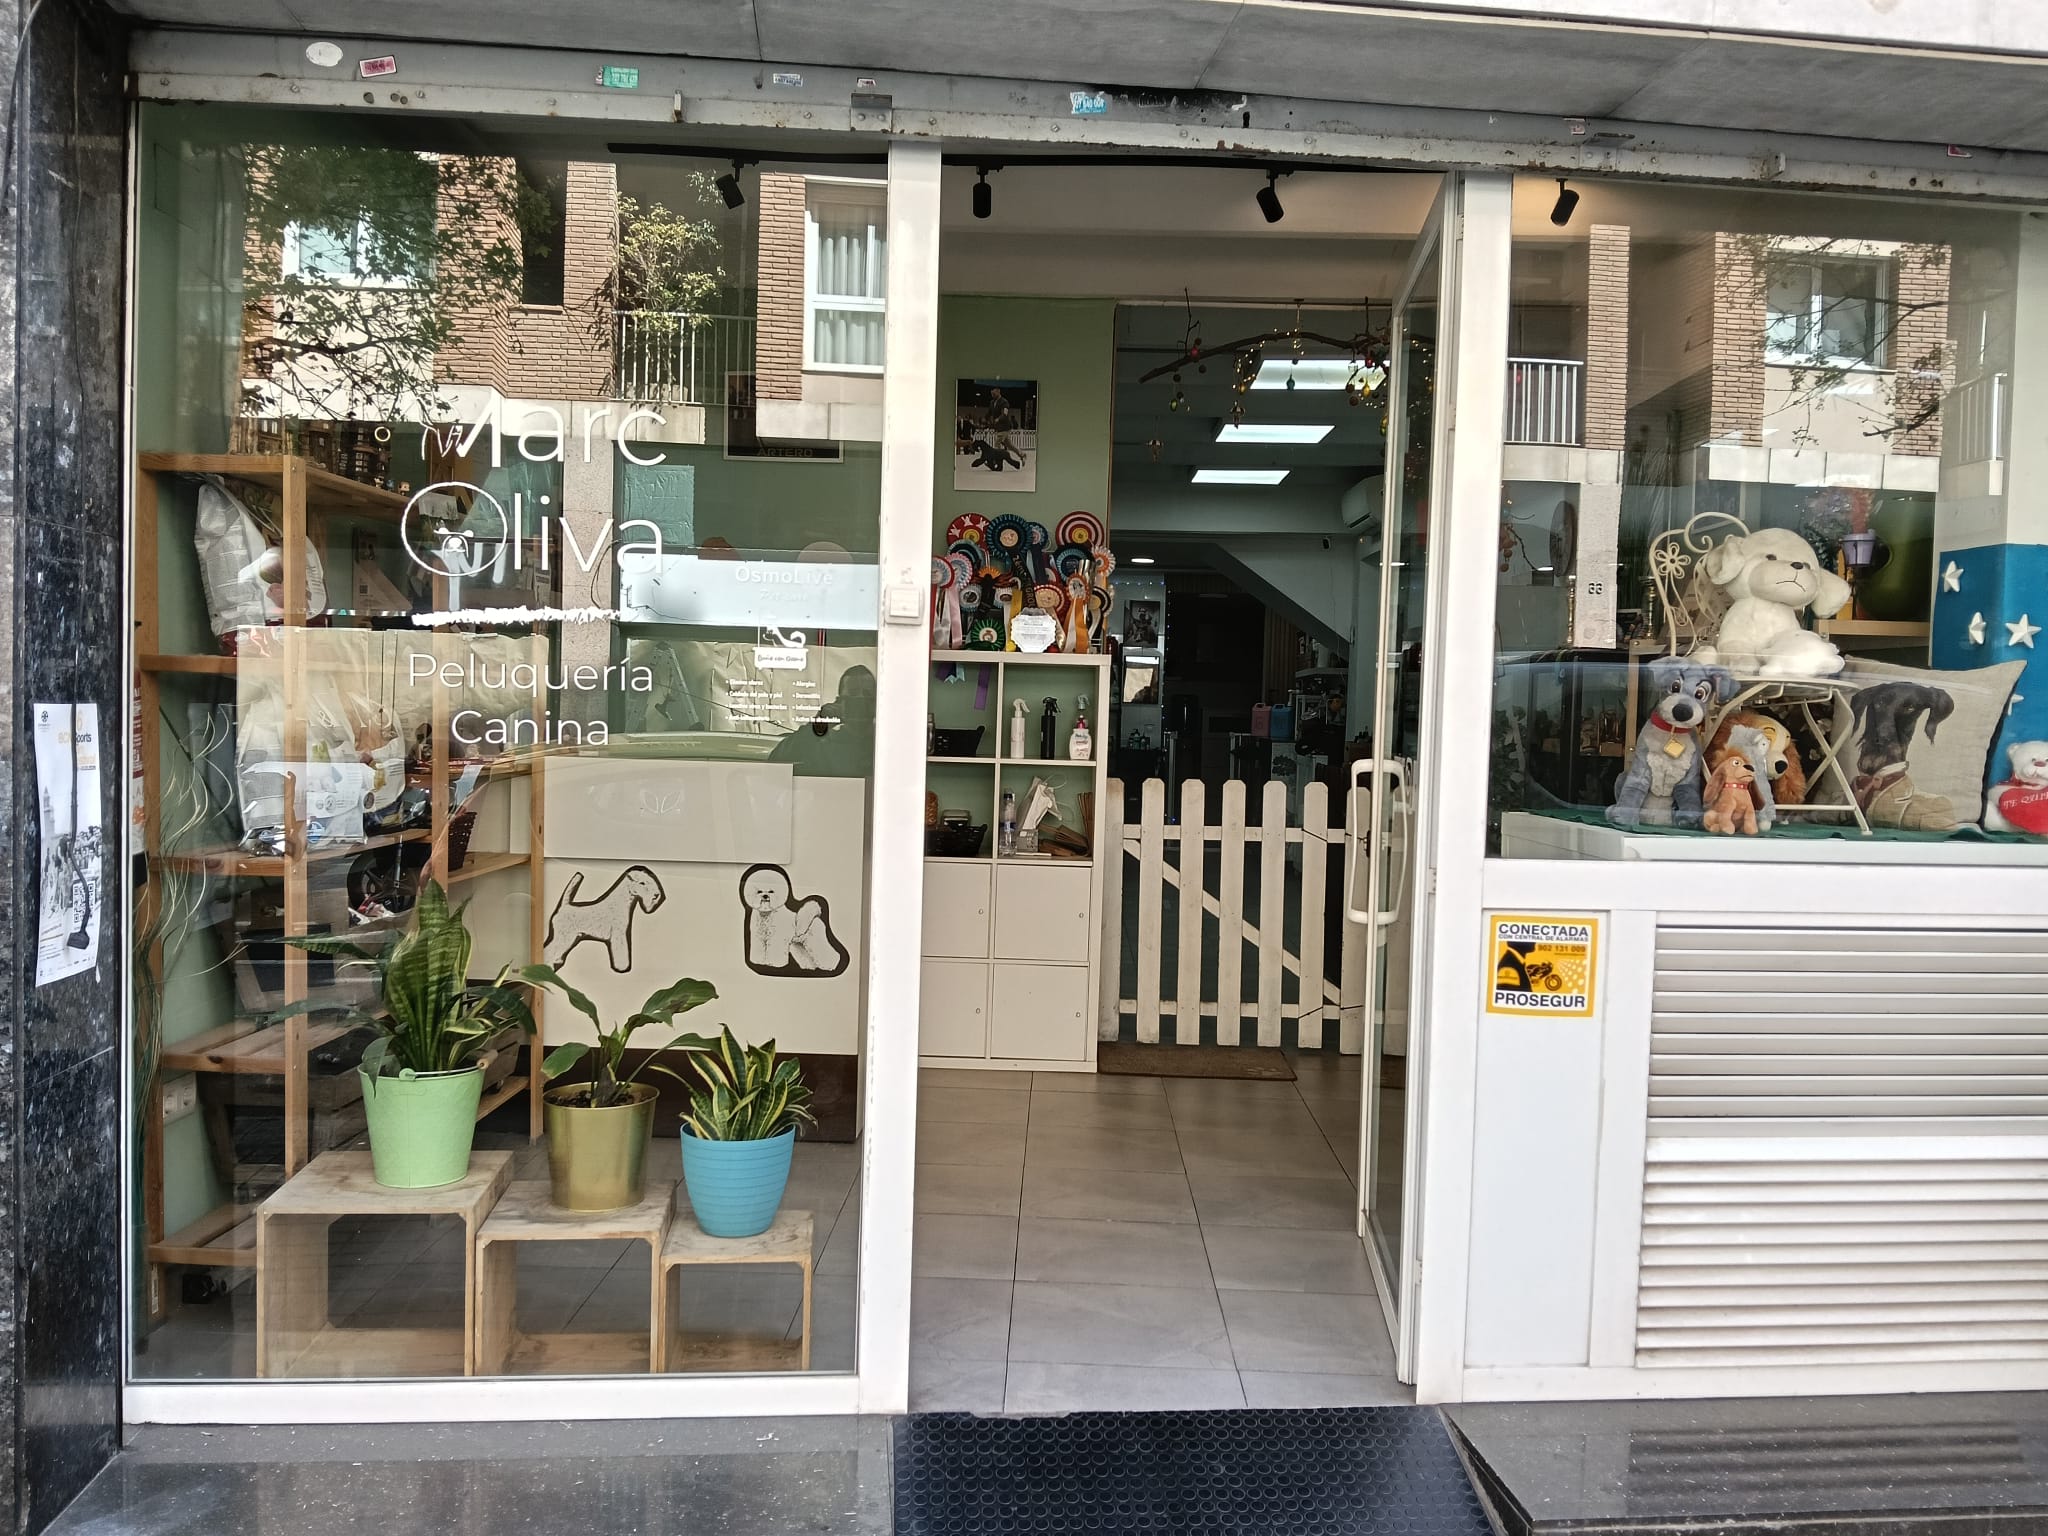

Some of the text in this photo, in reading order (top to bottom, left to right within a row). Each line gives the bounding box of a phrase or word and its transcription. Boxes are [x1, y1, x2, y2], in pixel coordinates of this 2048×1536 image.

[419, 389, 667, 467] Marc
[756, 447, 814, 457] ARTERO
[401, 481, 663, 576] Oliva
[408, 653, 653, 697] Peluquería
[451, 710, 609, 745] Canina
[1499, 923, 1589, 937] CONECTADA
[1495, 992, 1585, 1008] PROSEGUR
